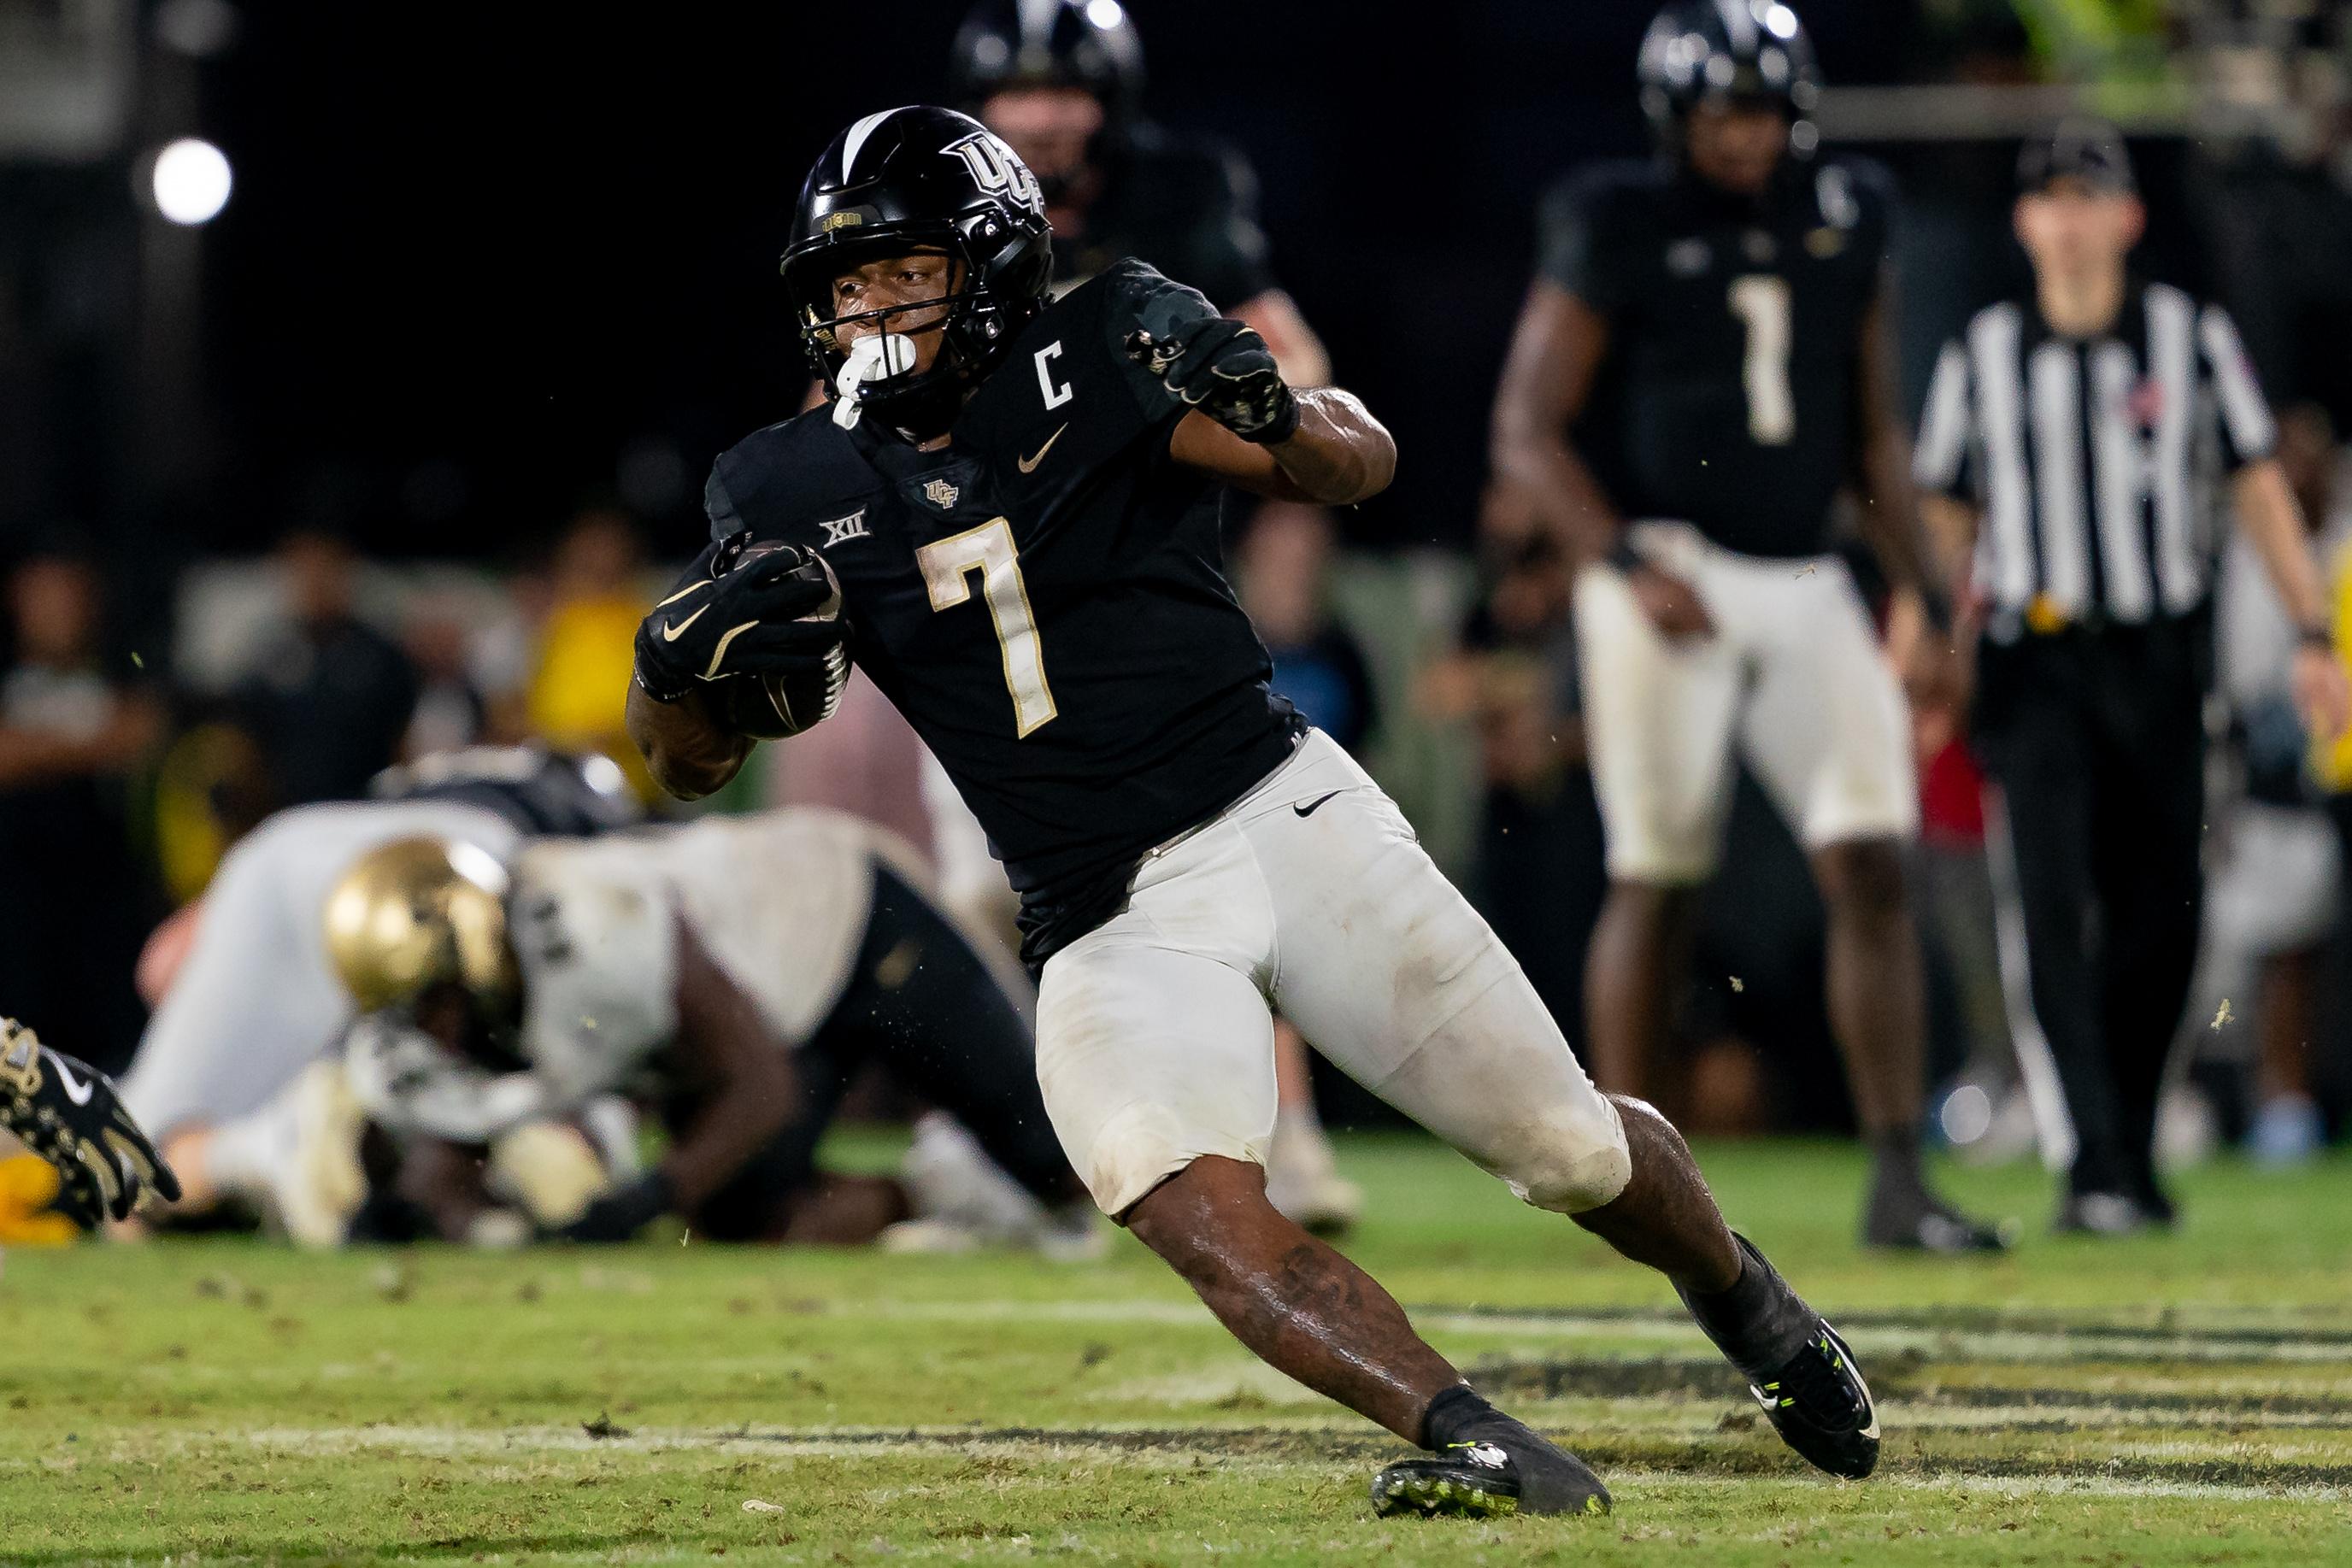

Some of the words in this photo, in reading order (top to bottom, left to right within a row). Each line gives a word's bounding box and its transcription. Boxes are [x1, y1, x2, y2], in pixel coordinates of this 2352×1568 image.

[1034, 340, 1073, 410] C
[1726, 274, 1796, 445] 1
[818, 508, 873, 549] XII
[923, 479, 958, 509] UCF
[915, 516, 1058, 740] 7
